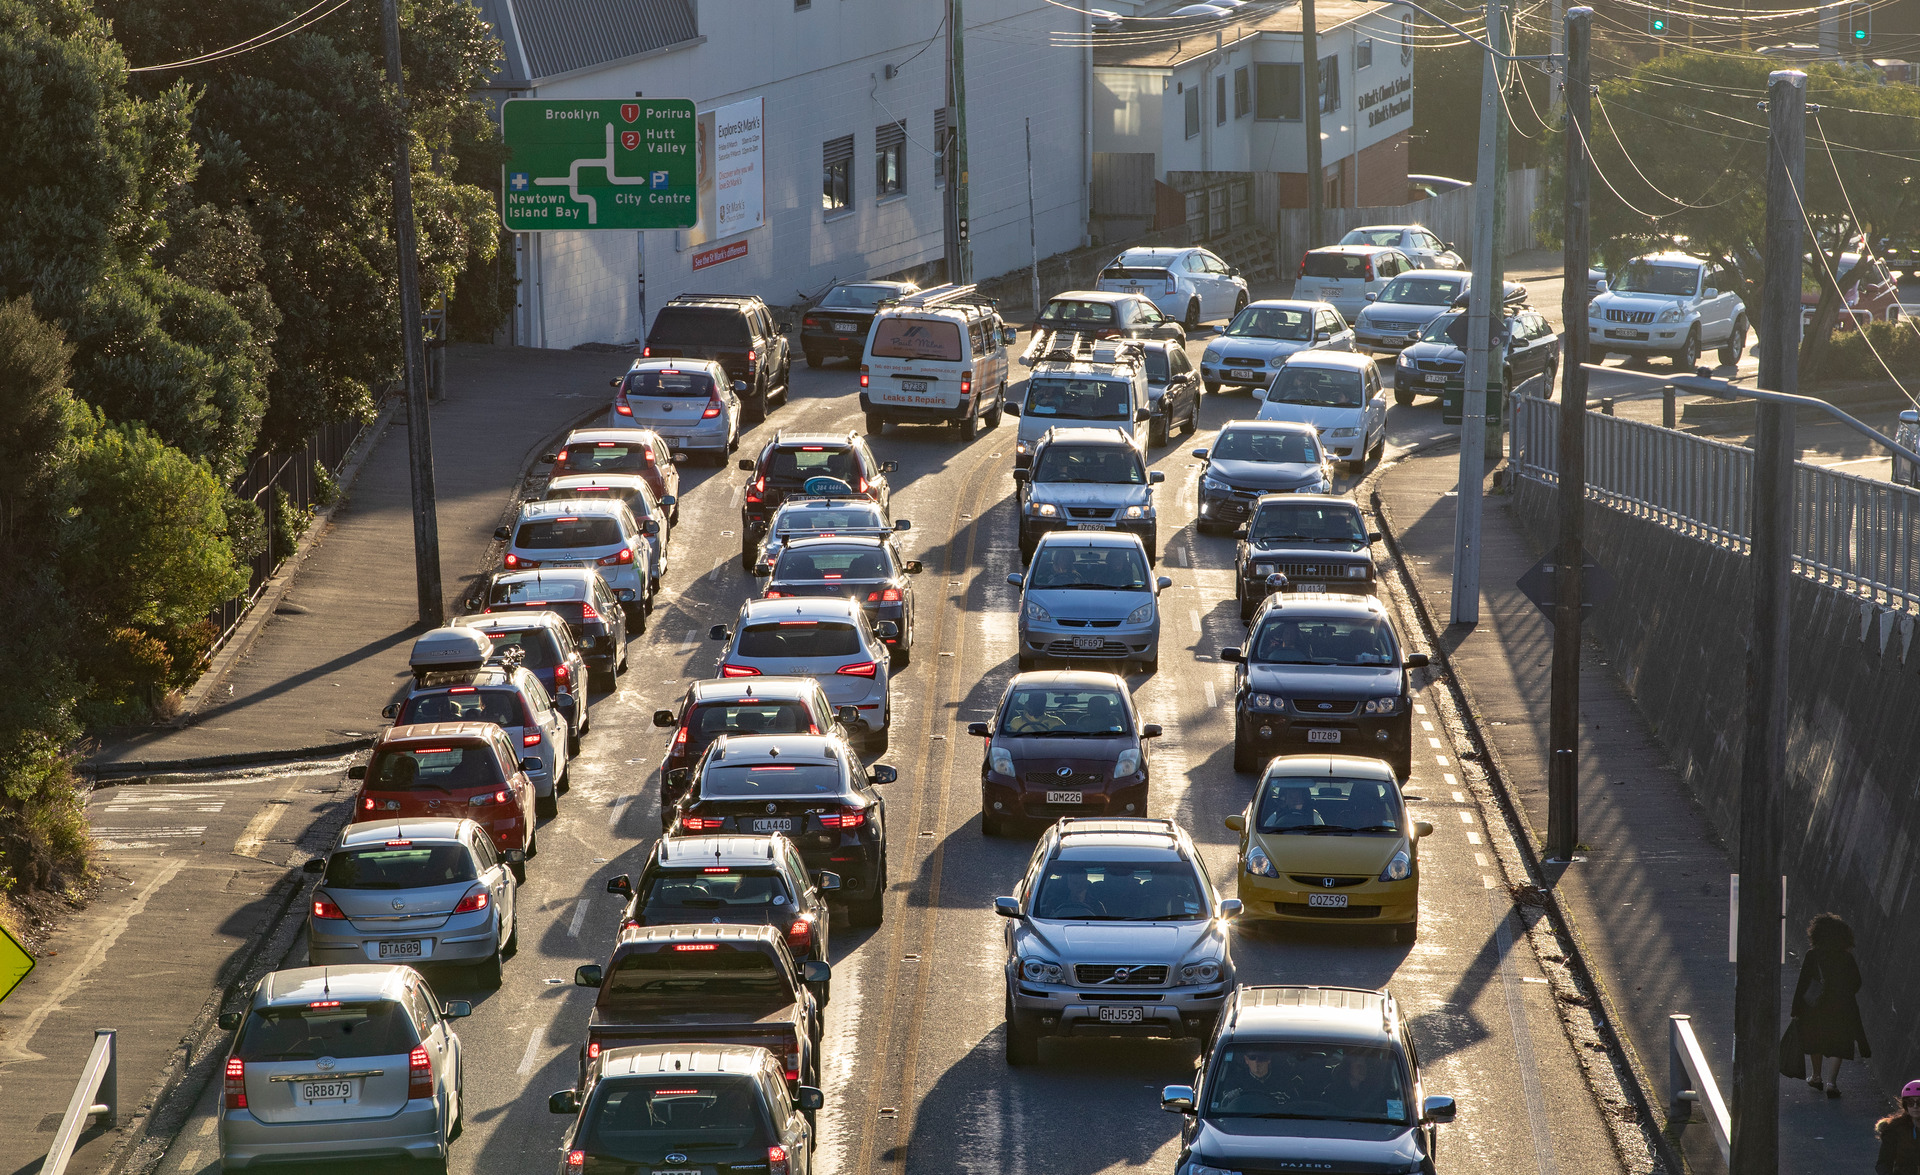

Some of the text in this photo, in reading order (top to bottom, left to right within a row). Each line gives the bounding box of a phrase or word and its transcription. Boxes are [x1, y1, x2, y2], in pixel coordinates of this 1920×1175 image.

[545, 109, 600, 122] Brooklyn
[628, 107, 632, 118] 1
[646, 108, 691, 119] Porirua
[718, 116, 760, 139] Explore St Mark's
[646, 128, 676, 139] Hutt
[626, 134, 635, 146] 2
[647, 142, 687, 155] Valley
[509, 193, 566, 204] Newtown
[615, 193, 691, 206] City Centre
[509, 207, 580, 219] Island Bay
[727, 245, 746, 257] difference
[883, 394, 906, 402] Leaks
[915, 396, 946, 405] Repairs
[1074, 637, 1102, 647] EDF697
[1311, 731, 1338, 740] DTZ89
[1048, 792, 1080, 802] LQM226
[754, 820, 791, 831] KLA448
[1309, 895, 1347, 906] CQZ599
[381, 942, 419, 955] BTA609
[1101, 1008, 1141, 1021] GHJ593
[306, 1083, 350, 1098] GRB879
